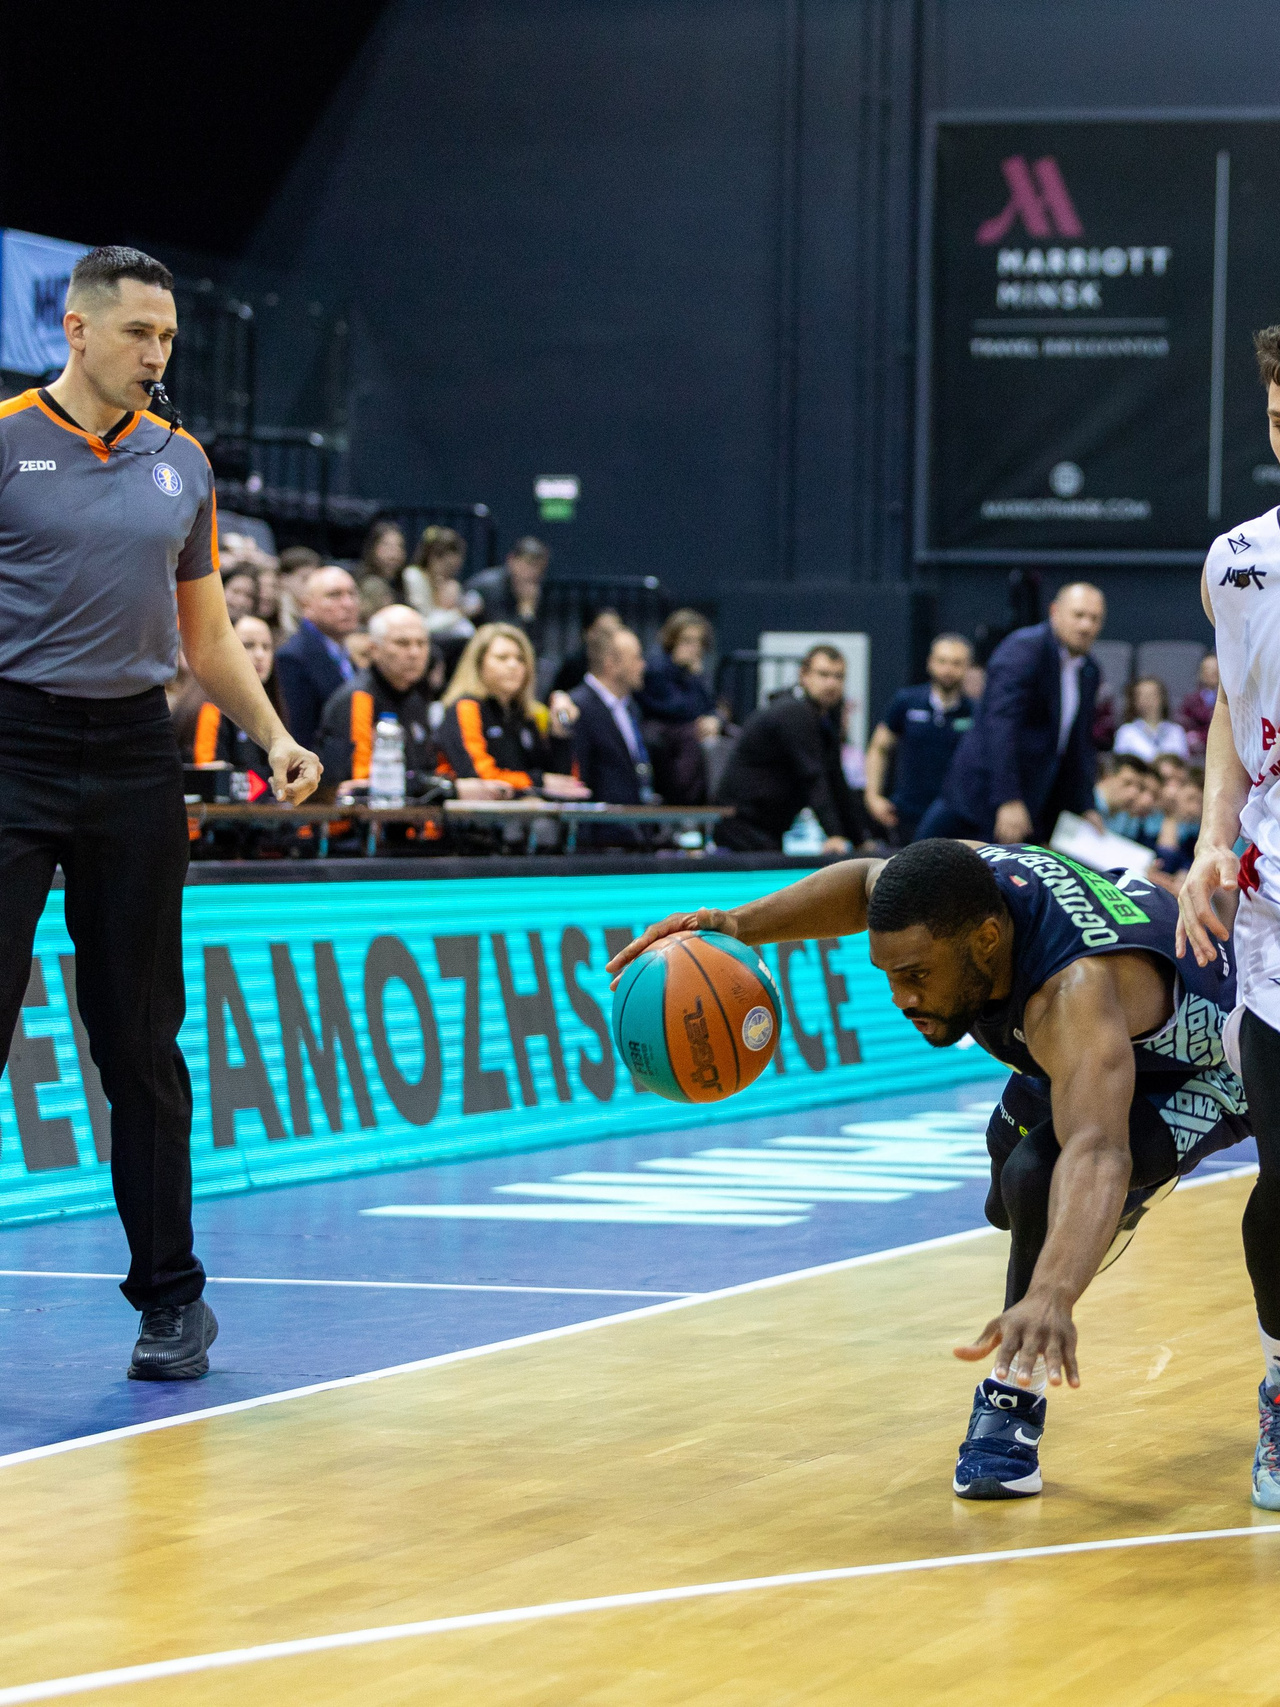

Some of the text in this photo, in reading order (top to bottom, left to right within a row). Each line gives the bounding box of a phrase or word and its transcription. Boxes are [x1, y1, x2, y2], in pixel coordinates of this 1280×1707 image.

[997, 247, 1172, 276] MARRIOTT
[997, 280, 1102, 309] MINSK
[19, 460, 57, 472] ZEDO
